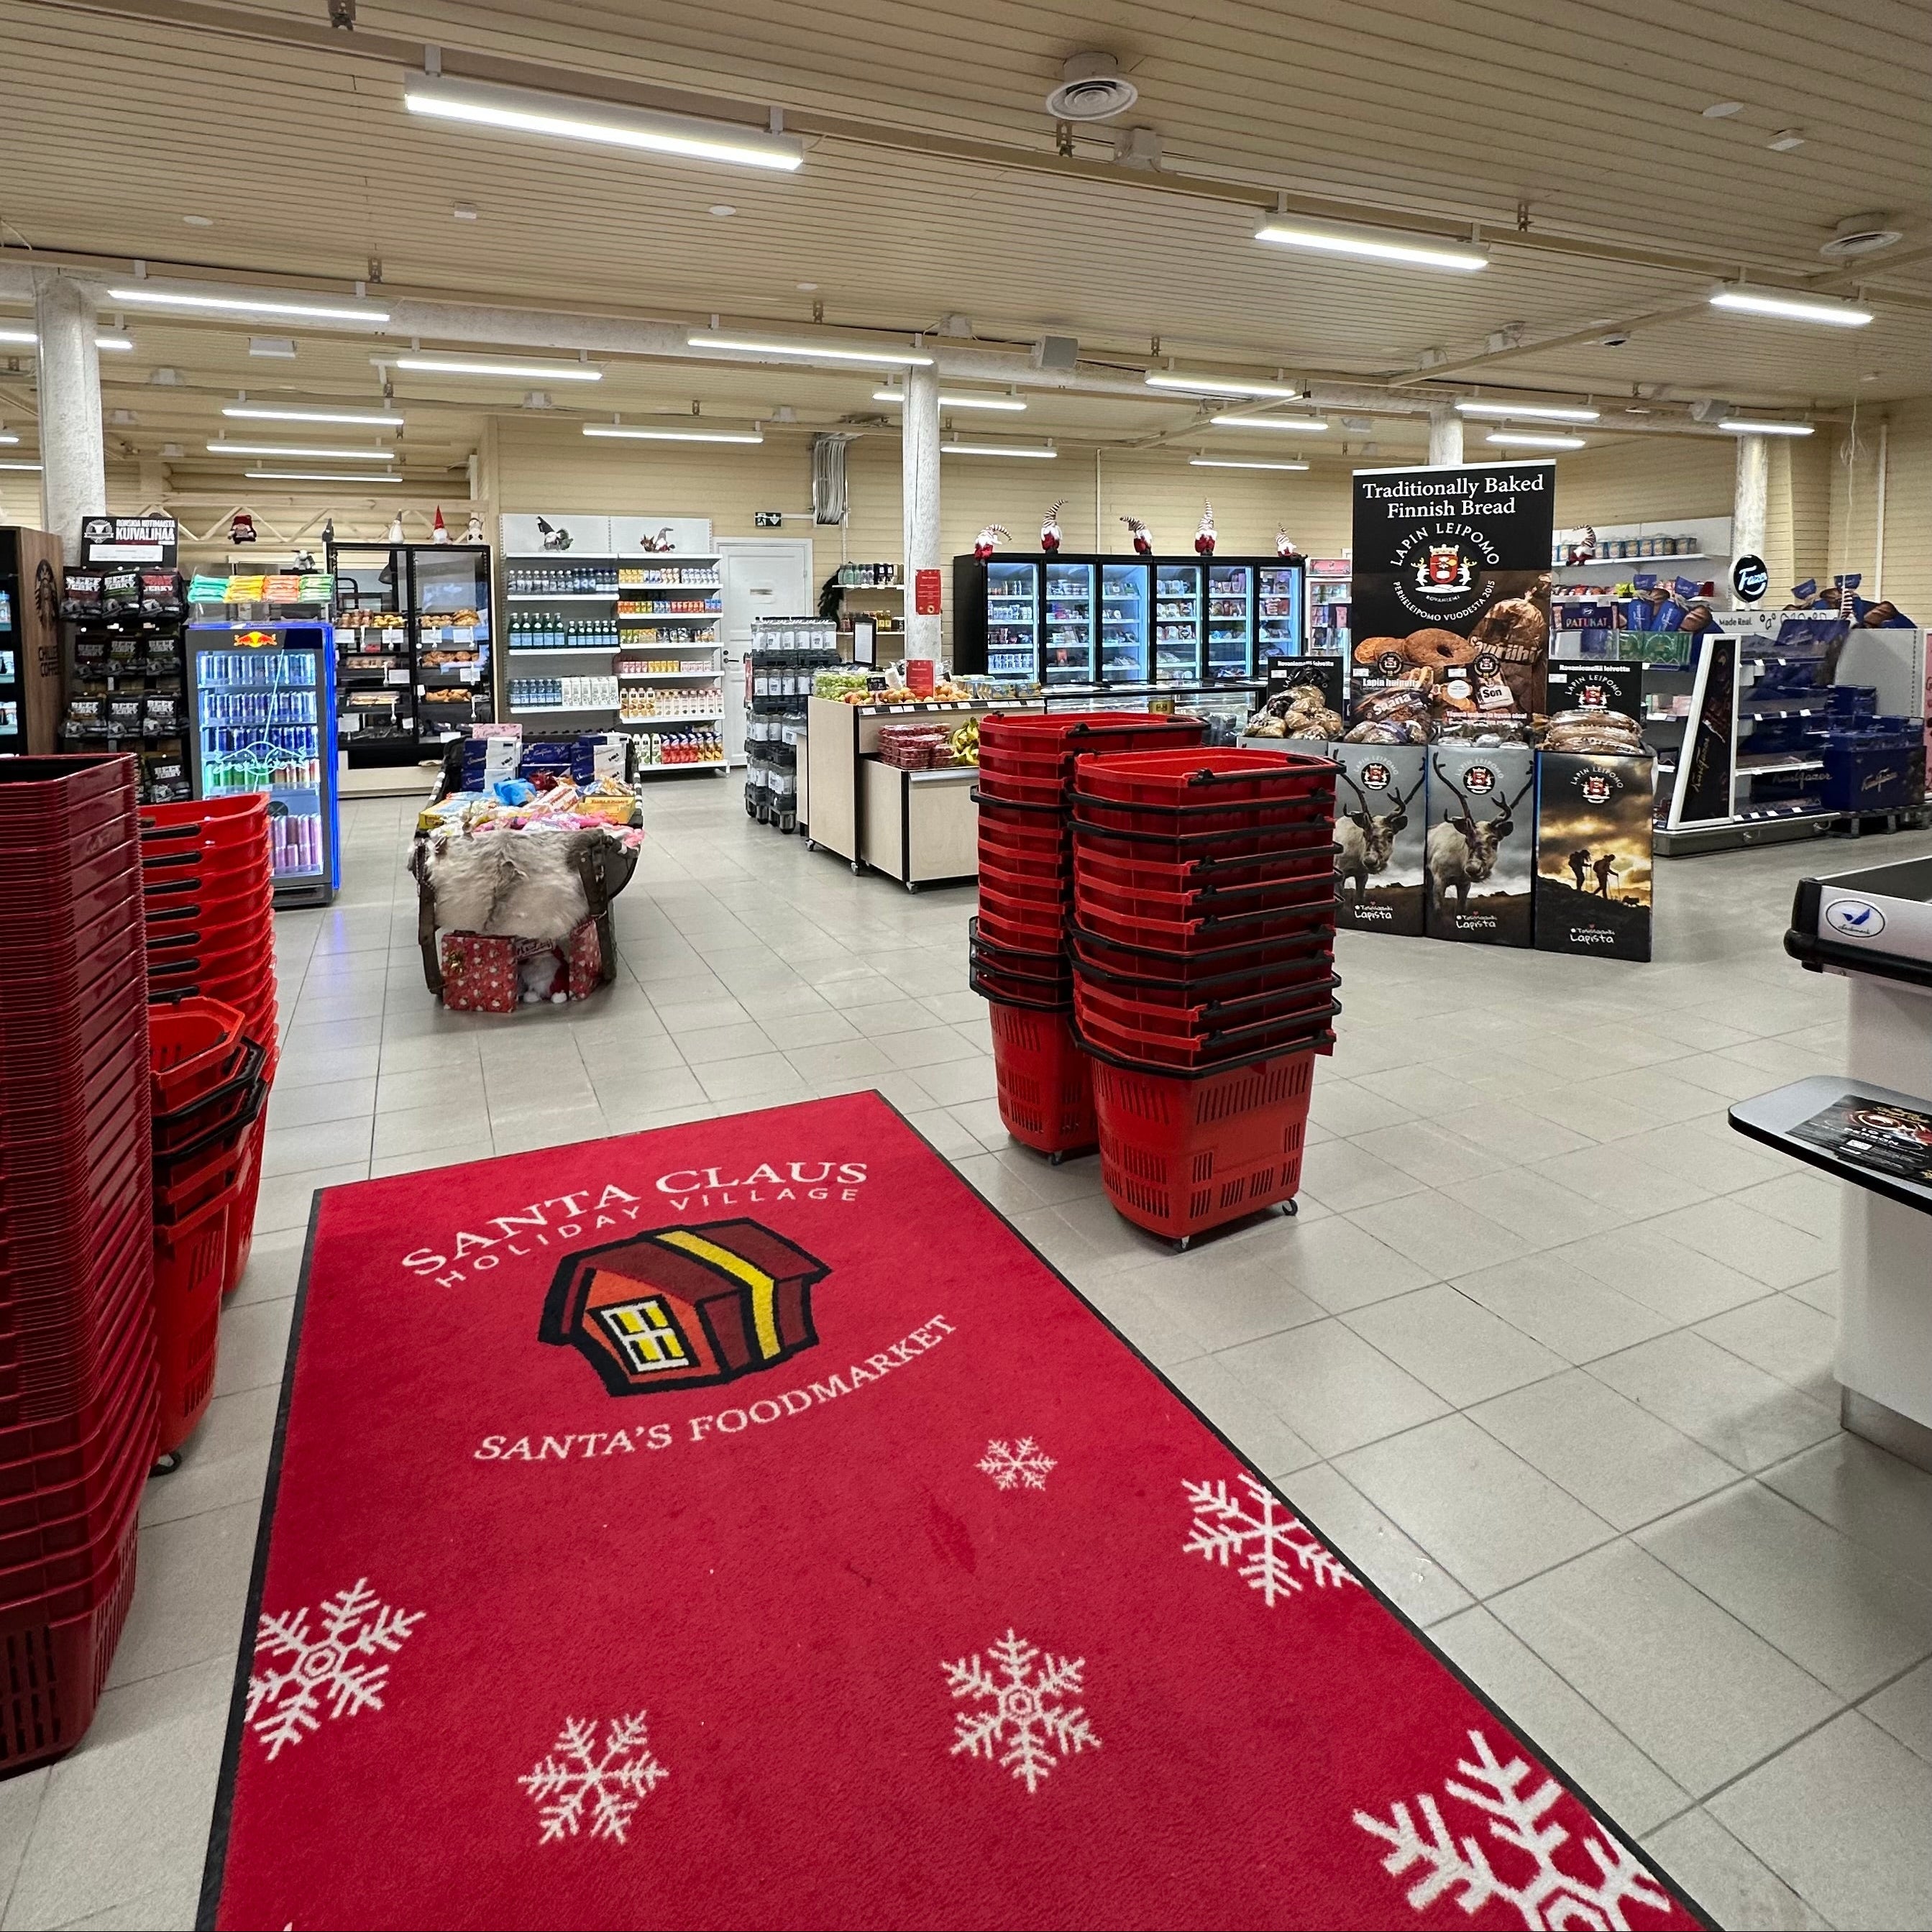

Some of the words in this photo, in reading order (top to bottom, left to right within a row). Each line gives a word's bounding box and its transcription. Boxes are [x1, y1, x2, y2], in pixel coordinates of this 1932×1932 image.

[1363, 477, 1480, 499] Traditionally
[1484, 474, 1544, 493] Baked
[1387, 500, 1455, 518] Finnish
[1461, 498, 1516, 516] Bread
[116, 527, 175, 541] KUIVALIHAA
[1391, 526, 1429, 567] LAPIN
[1436, 522, 1500, 565] LEIPOMO
[1393, 581, 1441, 621] PERHELEIPOMO
[1443, 598, 1485, 621] VUODESTA
[1483, 580, 1496, 599] 2015
[1566, 618, 1608, 628] PATUKAT
[1565, 676, 1586, 695] LAPIN
[1588, 674, 1622, 697] LEIPOMO
[1372, 755, 1399, 775] LEIPOMO
[1570, 767, 1590, 785] LAPIN
[1592, 766, 1624, 788] LEIPOMO
[1354, 910, 1393, 921] Lapista
[1455, 920, 1496, 930] Lapista
[1569, 933, 1615, 945] Lapista
[401, 1184, 642, 1276] SANTA
[655, 1161, 867, 1194] CLAUS
[434, 1205, 639, 1288] HOLIDAY
[669, 1188, 859, 1211] VILLAGE
[472, 1422, 672, 1461] SANTA'S
[687, 1314, 957, 1441] FOODMARKET
